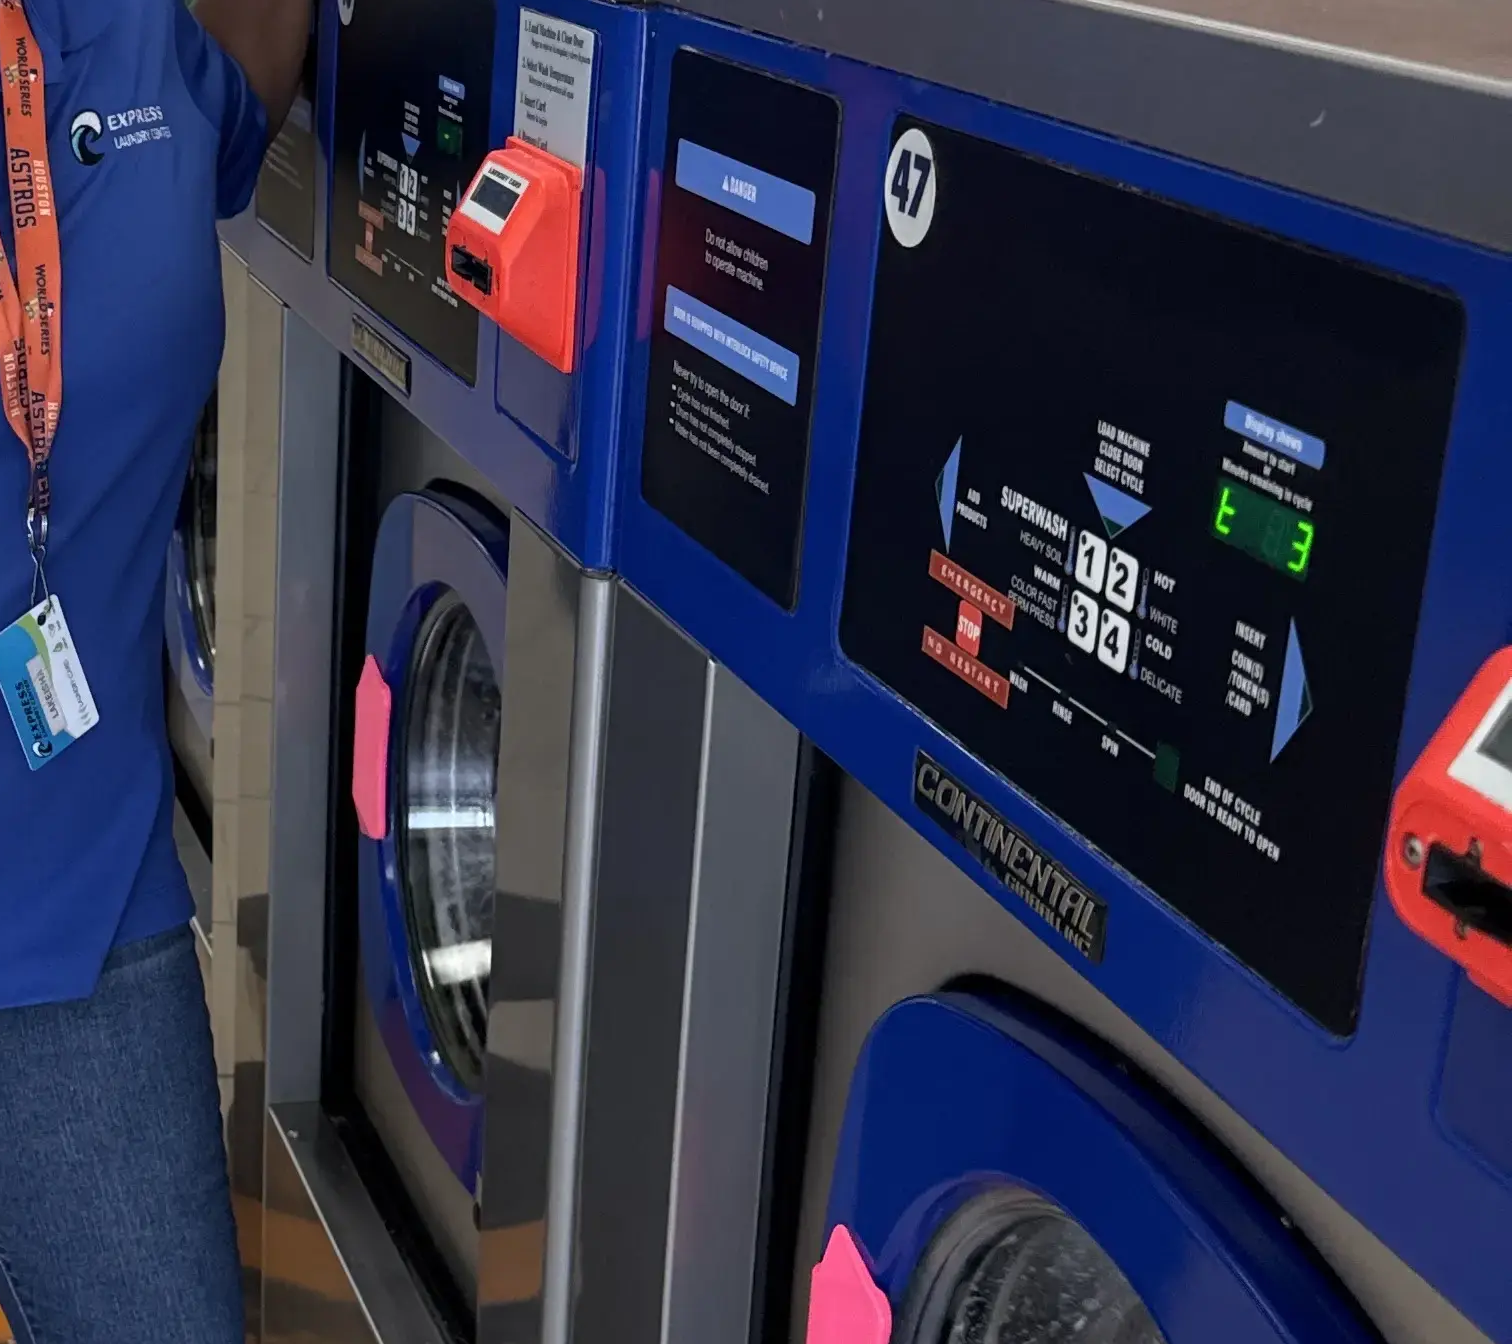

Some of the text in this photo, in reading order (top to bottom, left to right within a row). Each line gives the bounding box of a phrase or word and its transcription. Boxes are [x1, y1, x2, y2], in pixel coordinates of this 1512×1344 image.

[15, 36, 32, 117] WORLD SERIES
[107, 106, 163, 131] EXPRESS
[9, 147, 37, 229] ASTROS
[33, 159, 51, 217] HOUSTON
[730, 176, 757, 204] DANGER
[891, 148, 931, 218] 47
[705, 228, 768, 271] Do not allow children
[705, 250, 764, 292] to operate machine.
[35, 264, 52, 356] WORLD SERIES
[3, 353, 21, 417] HOUSTON
[673, 359, 689, 380] Never
[698, 375, 704, 391] to
[704, 382, 719, 400] open
[720, 389, 729, 406] the
[730, 396, 744, 416] door
[770, 361, 788, 382] DEVICE
[1097, 420, 1151, 457] LOAD MACHINE
[1244, 413, 1303, 453] Display shows
[1094, 457, 1144, 494] SELECT CYCLE
[1099, 440, 1143, 474] CLOSE DOOR
[967, 488, 980, 505] ADD
[1222, 457, 1249, 482] Minutes
[1249, 472, 1284, 500] remaining
[1293, 493, 1313, 512] cycle
[957, 501, 987, 529] PRODUCTS
[1000, 485, 1069, 541] SUPERWASH
[1019, 530, 1063, 566] HEAVY SOIL
[1286, 520, 1314, 572] 3
[940, 564, 1006, 614] EMERGENCY
[1034, 564, 1061, 591] WARM
[1085, 545, 1127, 598] 1 2
[1154, 571, 1176, 593] HOT
[1007, 591, 1055, 630] PERM PRESS
[1010, 574, 1058, 612] COLOR FAST
[957, 615, 980, 641] STOP
[1075, 605, 1119, 659] 3 4
[1149, 606, 1179, 634] WHITE
[1235, 620, 1266, 650] INSERT
[927, 635, 1000, 694] NO RESTART
[1145, 634, 1172, 660] COLD
[1231, 650, 1264, 682] COIN(S)
[1009, 670, 1028, 693] WASH
[1140, 667, 1182, 704] DELICATE
[1227, 671, 1269, 709] /TOKEN(S)
[15, 680, 42, 741] EXPRESS
[1052, 701, 1073, 725] RINSE
[1225, 690, 1252, 717] /CARD
[1101, 735, 1120, 757] SPIN
[1204, 776, 1261, 827] END OF CYCLE
[1184, 783, 1280, 862] DOOR IS READY TO OPEN
[917, 763, 1095, 940] CONTINENTAL
